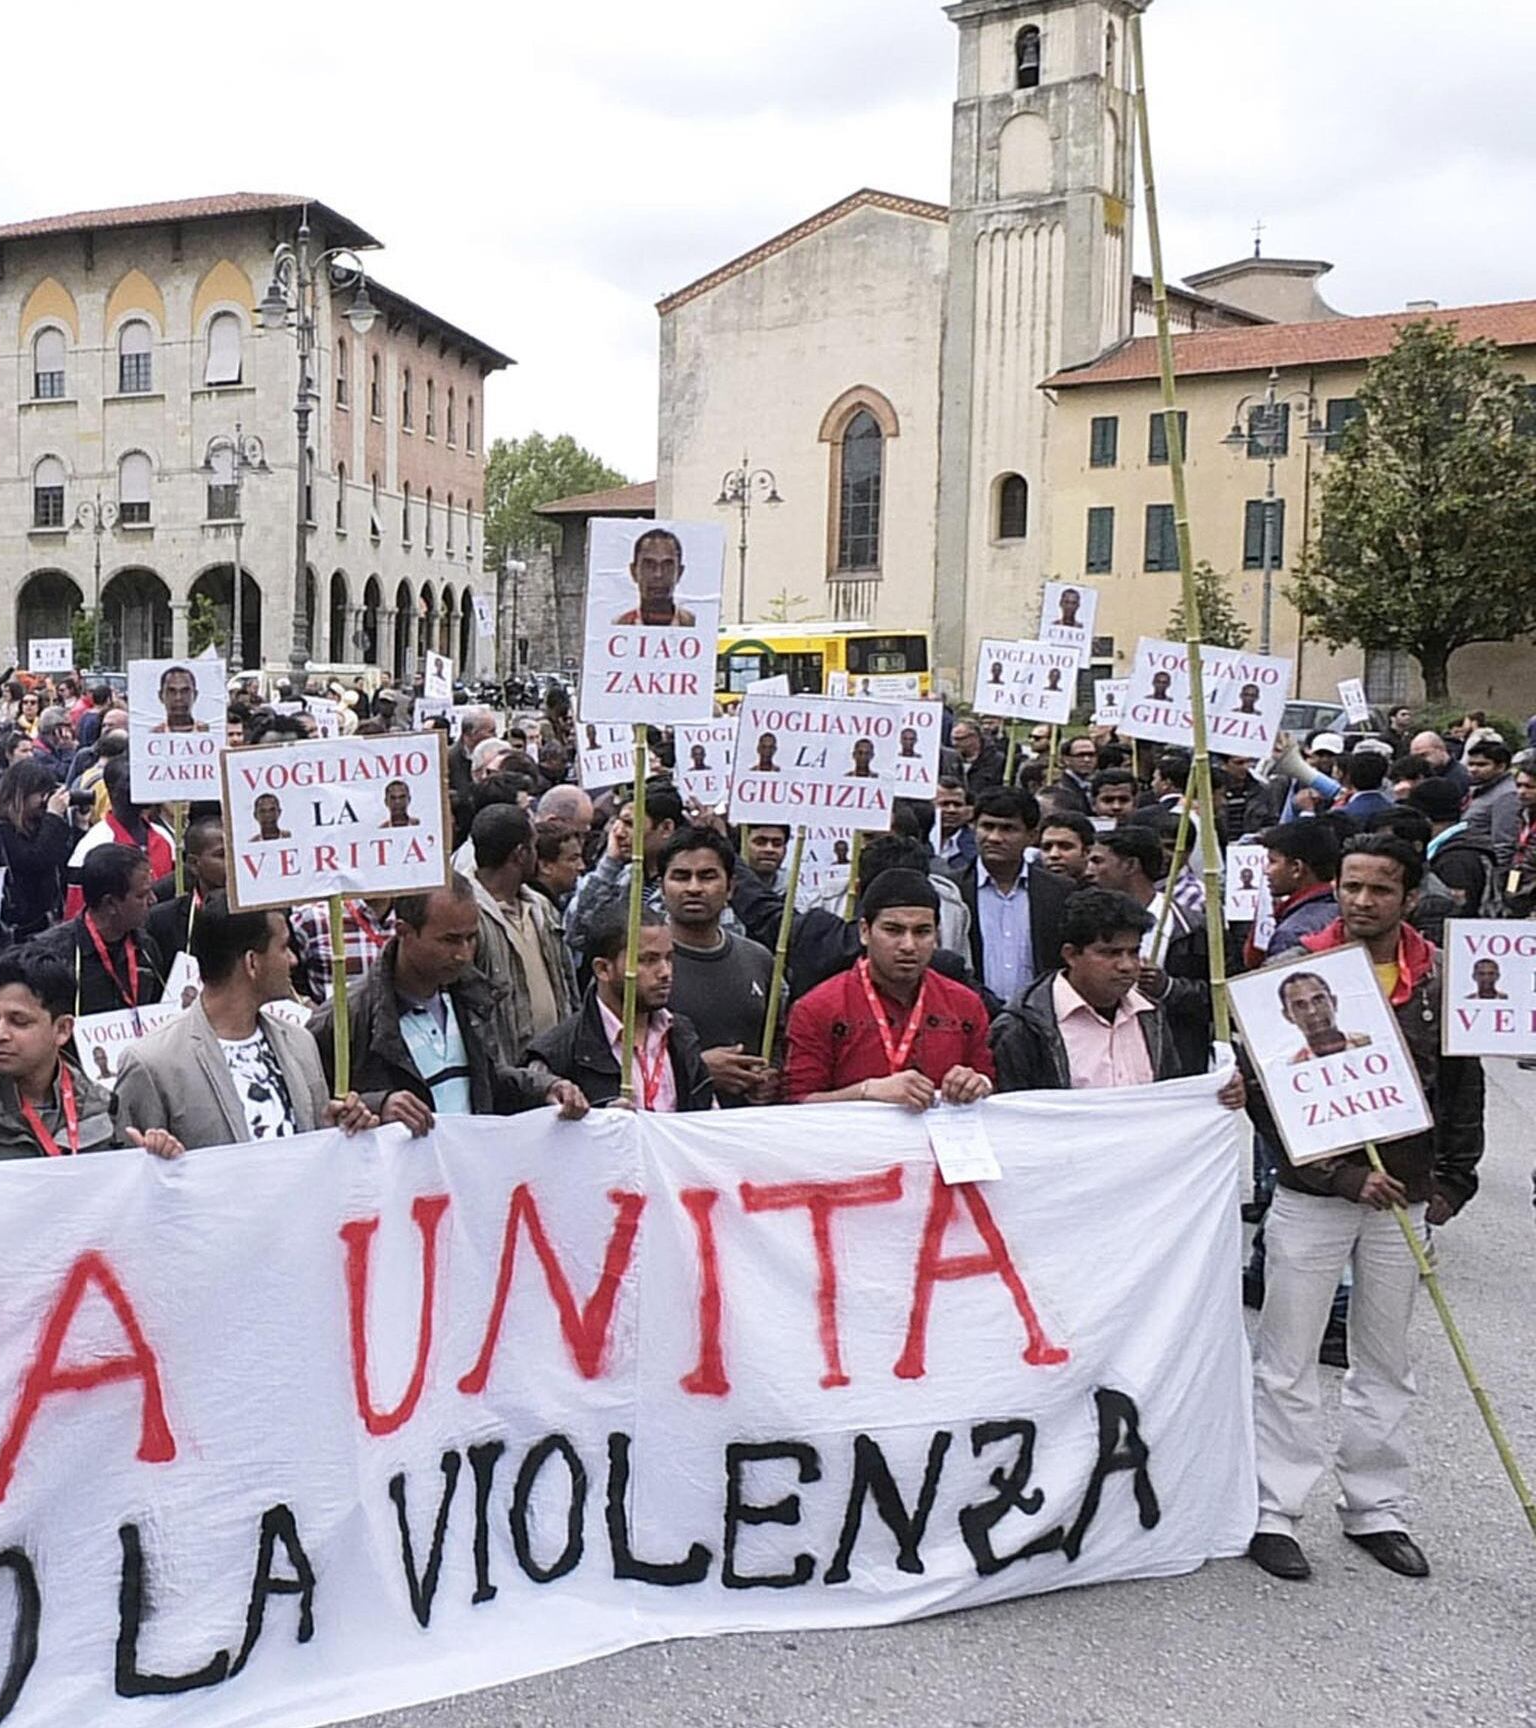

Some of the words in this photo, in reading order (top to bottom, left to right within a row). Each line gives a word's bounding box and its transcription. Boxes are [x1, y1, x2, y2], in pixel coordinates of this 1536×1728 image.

[608, 635, 701, 659] CIAO
[986, 647, 1074, 667] VOGLIAMO
[605, 671, 698, 695] ZAKIR
[995, 689, 1049, 710] PACE
[751, 709, 893, 738] VOGLIAMO
[1131, 703, 1267, 741] GIUSIZIA
[147, 739, 214, 756] CIAO
[794, 746, 827, 768] LA
[148, 764, 214, 781] ZAKIR
[241, 751, 429, 791] VOGLIAMO
[737, 779, 887, 810] GIUSTIZIA
[311, 800, 359, 827] LA
[243, 835, 434, 880] VERITA'
[1292, 1053, 1388, 1093] CIAO
[1303, 1085, 1404, 1126] ZAKIR
[337, 1161, 1072, 1440] UNITA
[114, 1503, 317, 1699] LA
[388, 1386, 1162, 1628] VIOLENZA
